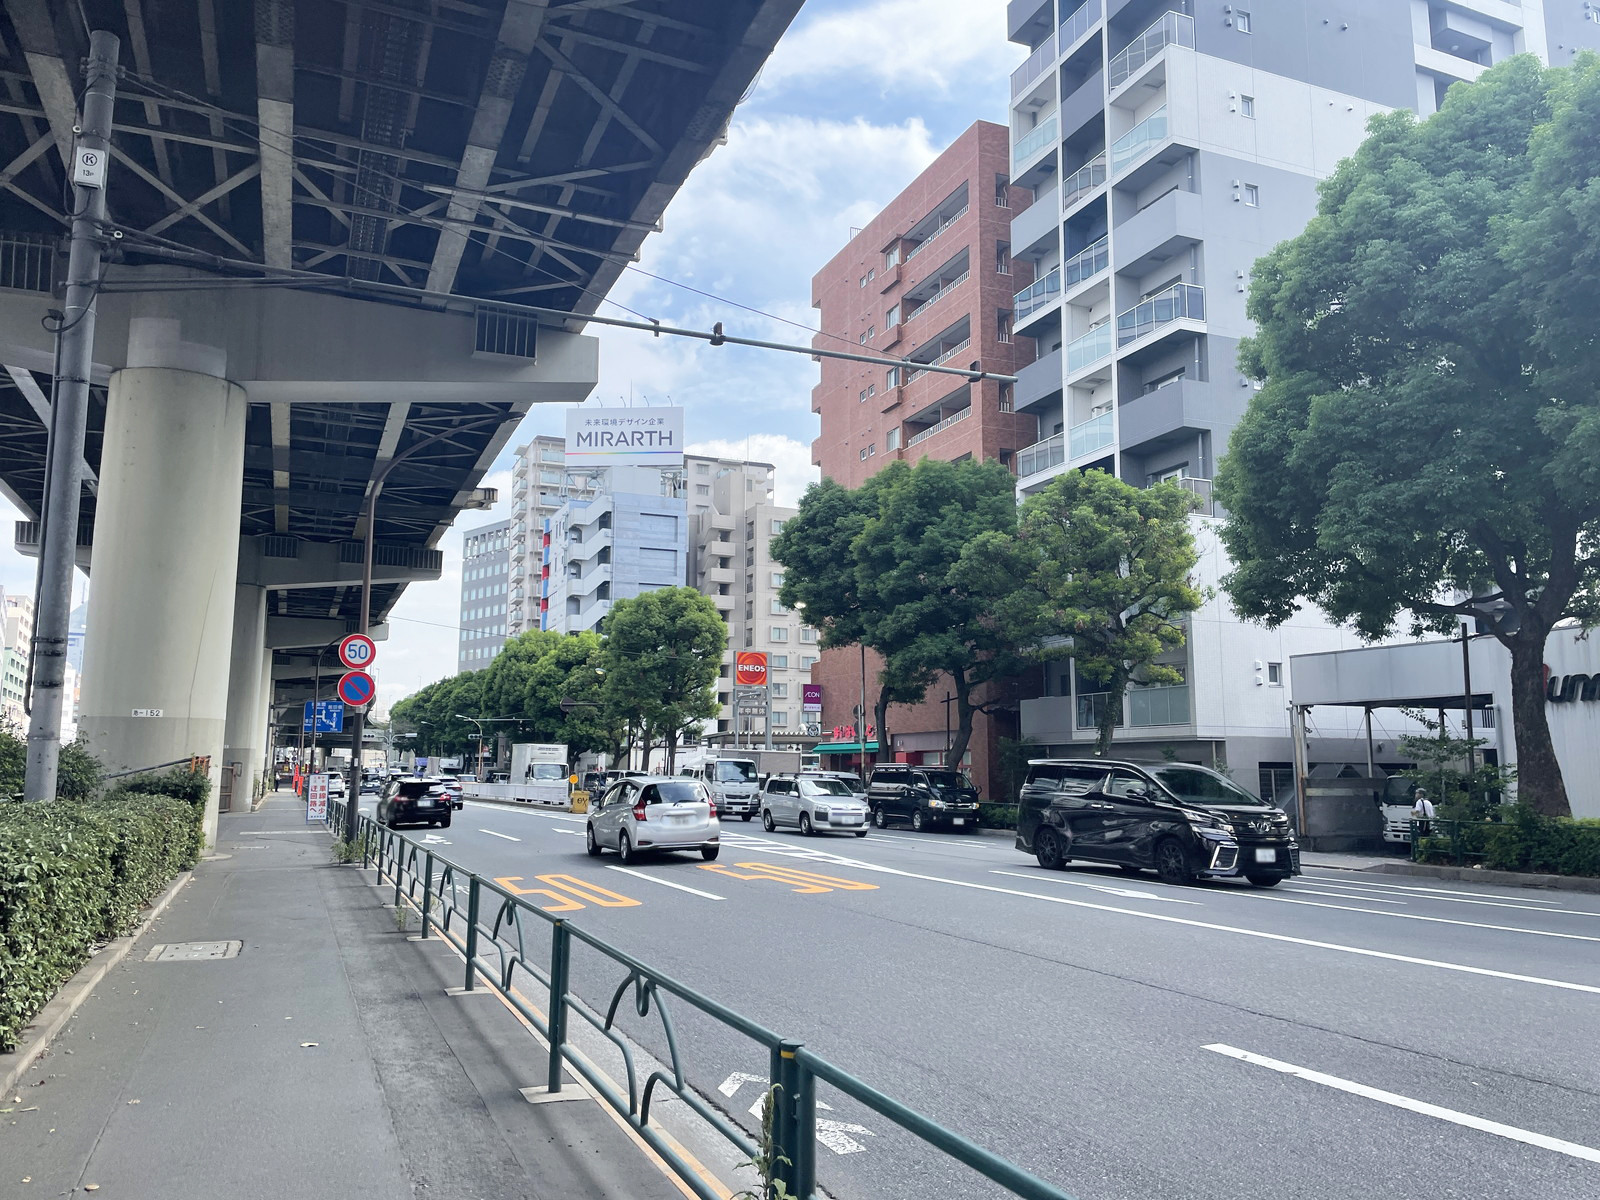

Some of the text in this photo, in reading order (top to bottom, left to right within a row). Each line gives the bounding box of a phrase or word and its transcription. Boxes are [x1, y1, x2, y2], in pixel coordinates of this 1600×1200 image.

[584, 417, 665, 427] 未来環境デザイン企業
[576, 430, 673, 448] MIRARTH
[348, 643, 368, 660] 50
[738, 664, 765, 673] ENEOS
[493, 874, 643, 912] 50
